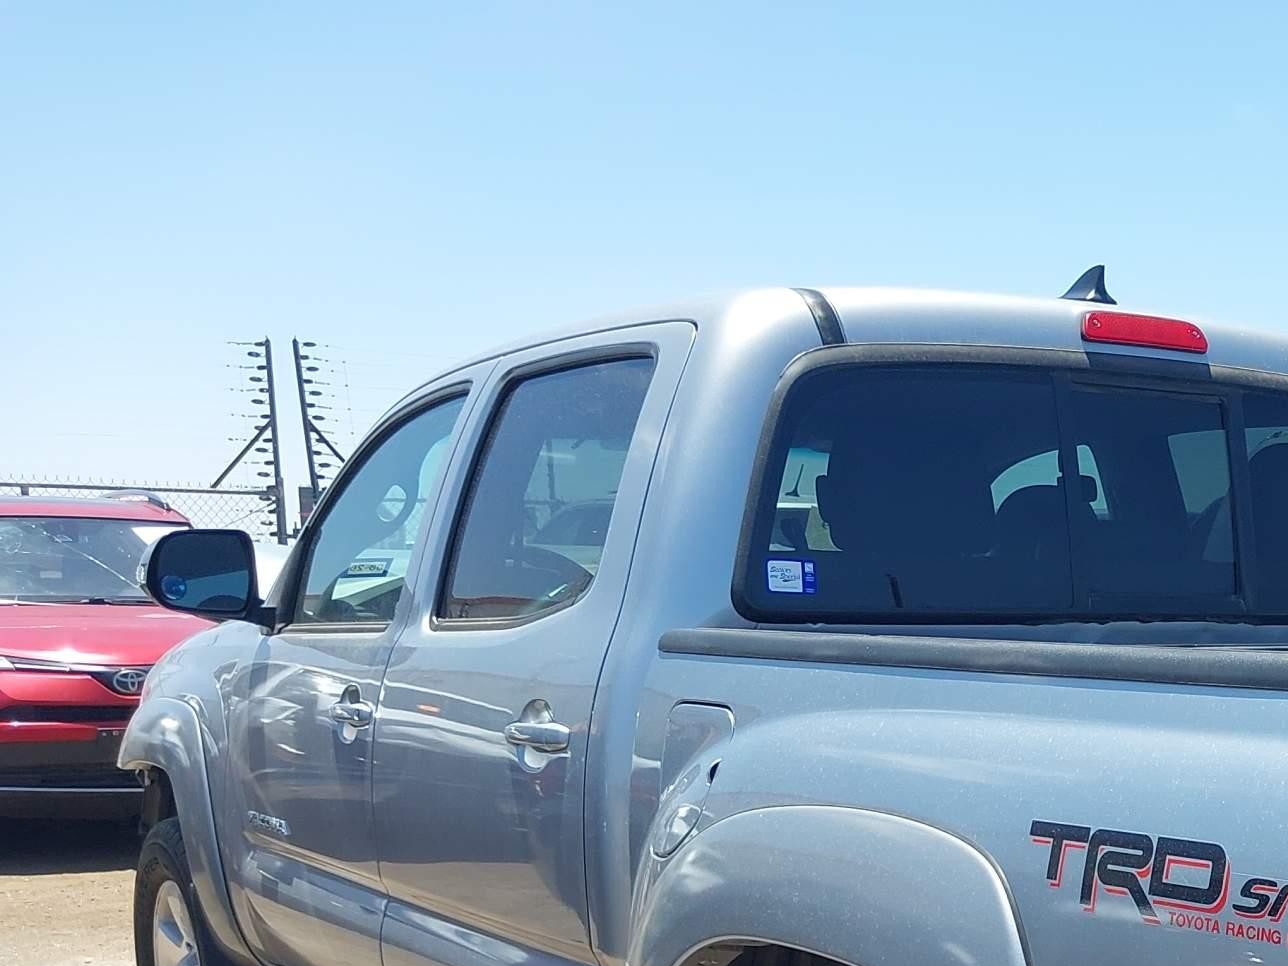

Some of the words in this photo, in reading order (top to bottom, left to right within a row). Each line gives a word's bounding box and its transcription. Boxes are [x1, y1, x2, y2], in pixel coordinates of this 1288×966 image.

[1029, 819, 1231, 925] TRD
[1167, 911, 1220, 934] TOYOTA
[1225, 921, 1282, 945] RACING
